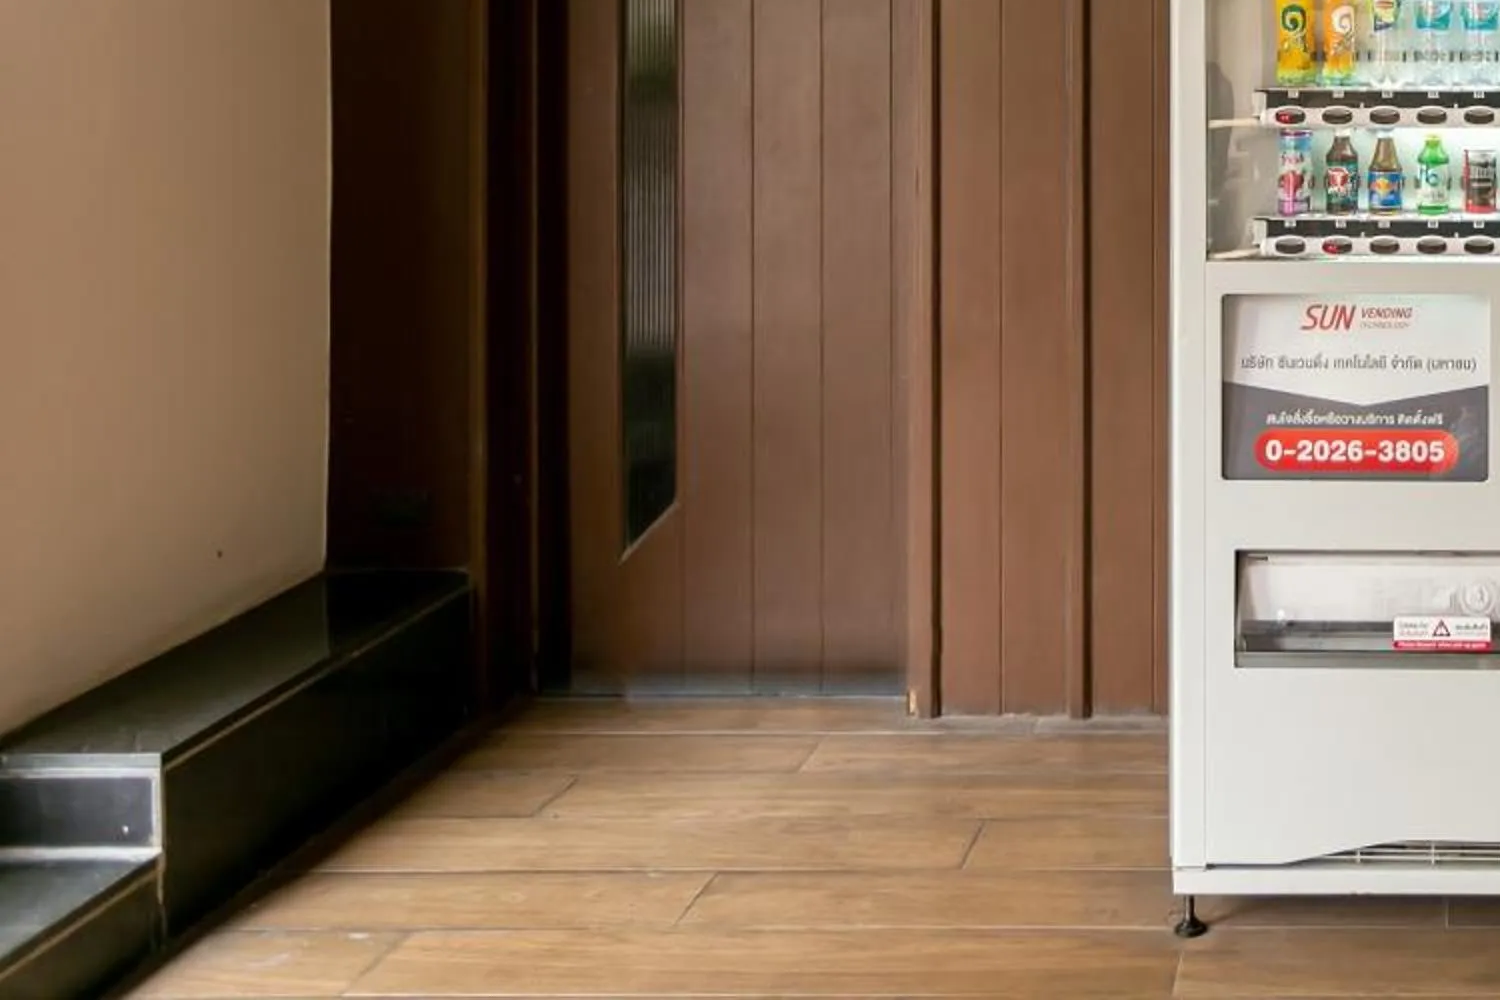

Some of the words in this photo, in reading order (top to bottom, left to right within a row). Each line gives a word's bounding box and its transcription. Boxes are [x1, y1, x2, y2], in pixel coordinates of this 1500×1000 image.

[1300, 303, 1357, 331] SUN
[1361, 307, 1413, 319] VENDING
[1241, 354, 1274, 369] บริษัท
[1391, 355, 1423, 370] จำกัด
[1427, 357, 1477, 372] (มหาชน)
[1265, 439, 1445, 463] 0-2026-3805
